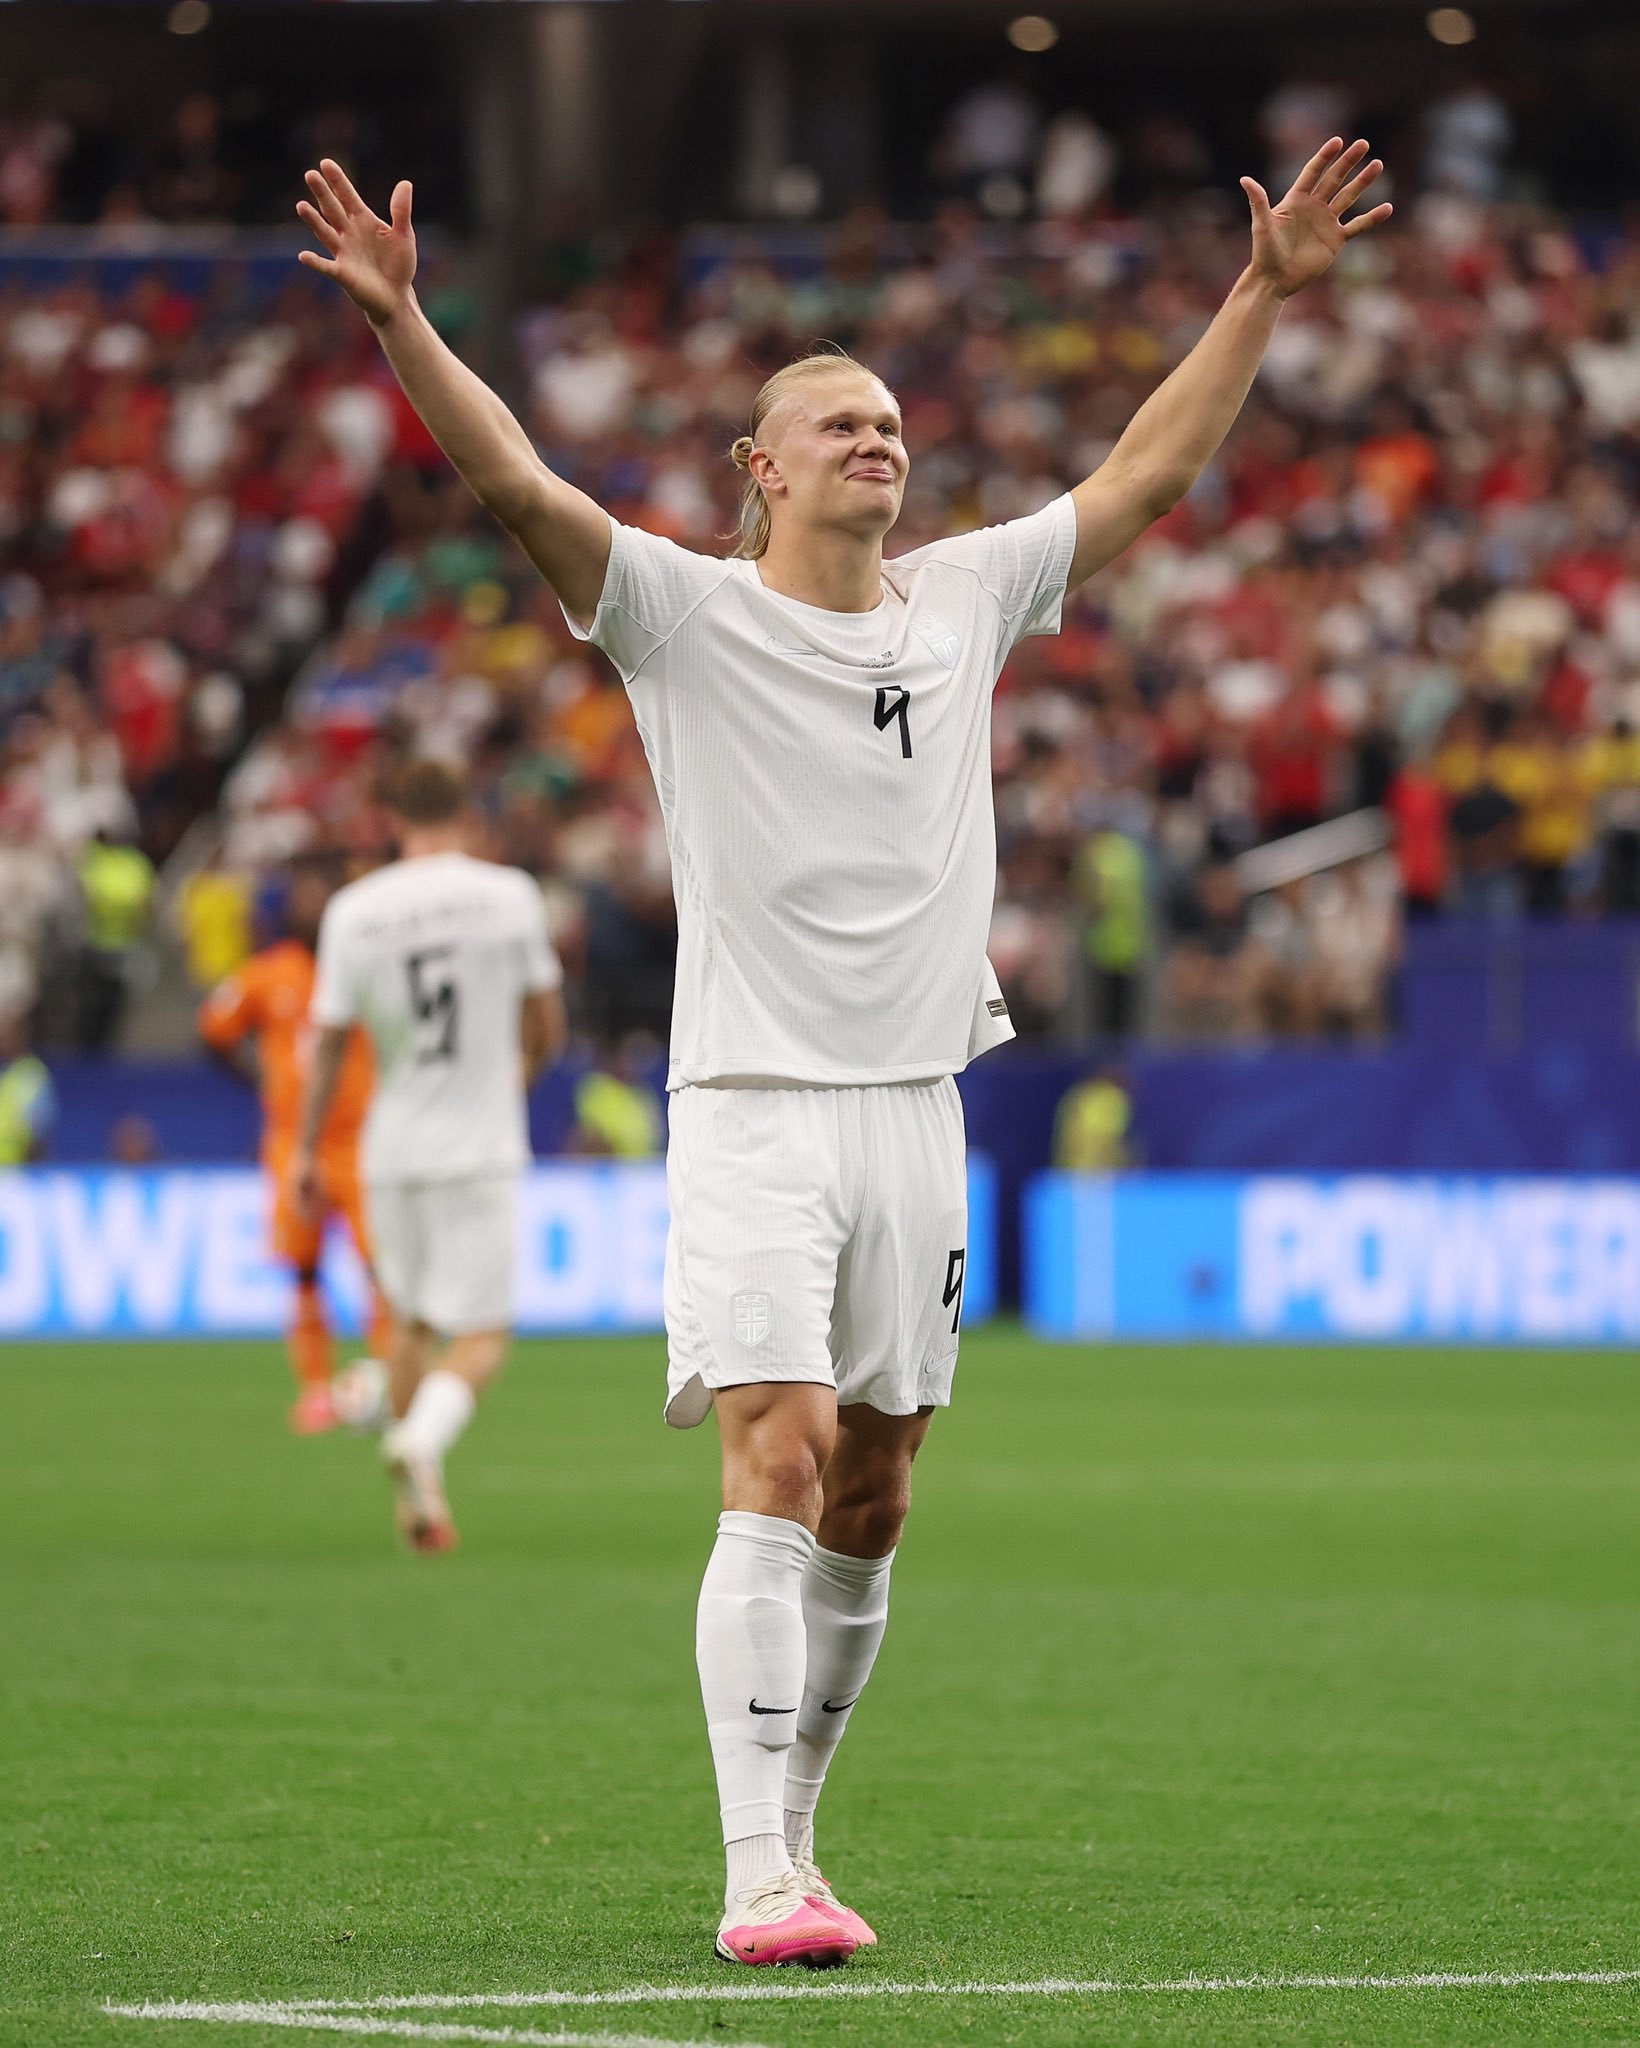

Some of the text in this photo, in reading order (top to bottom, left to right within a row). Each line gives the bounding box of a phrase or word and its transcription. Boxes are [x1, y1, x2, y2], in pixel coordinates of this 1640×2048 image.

[874, 685, 912, 759] 9
[405, 945, 459, 1068] 5
[942, 1248, 965, 1334] 9
